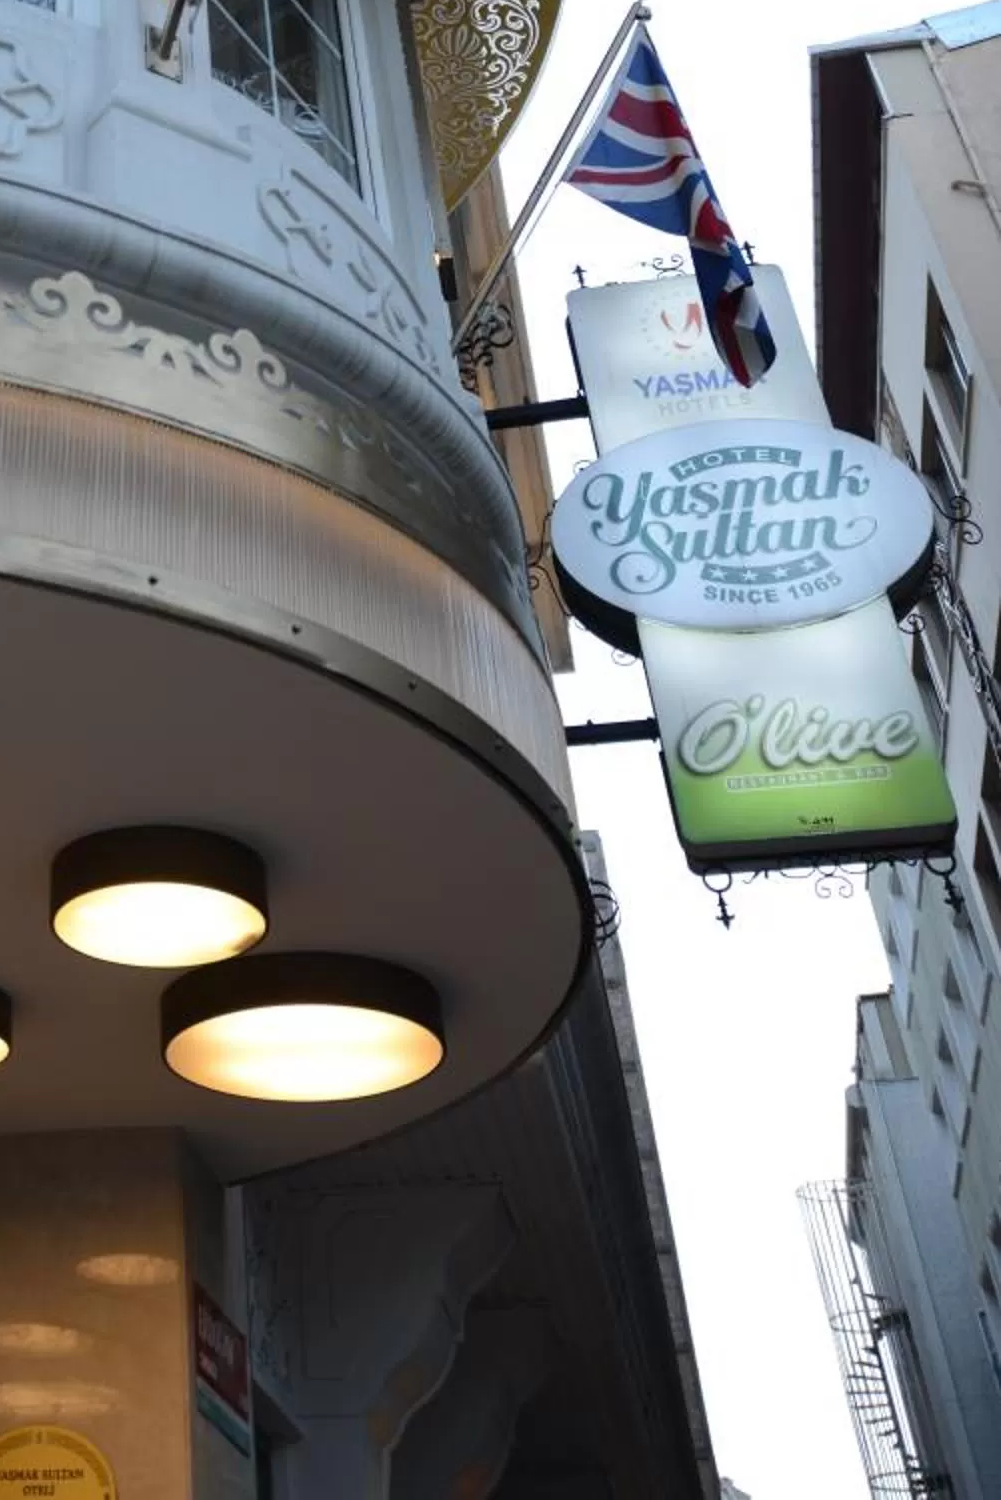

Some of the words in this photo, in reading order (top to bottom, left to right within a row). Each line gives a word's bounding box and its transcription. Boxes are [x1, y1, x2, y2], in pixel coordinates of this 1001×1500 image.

[633, 368, 767, 398] YAŞMA
[658, 392, 753, 418] HOTELS
[678, 449, 795, 478] HOTEL
[583, 449, 870, 546] Yaşmak
[609, 510, 878, 594] Sultan
[703, 583, 781, 605] SINCE
[787, 570, 843, 601] 1965
